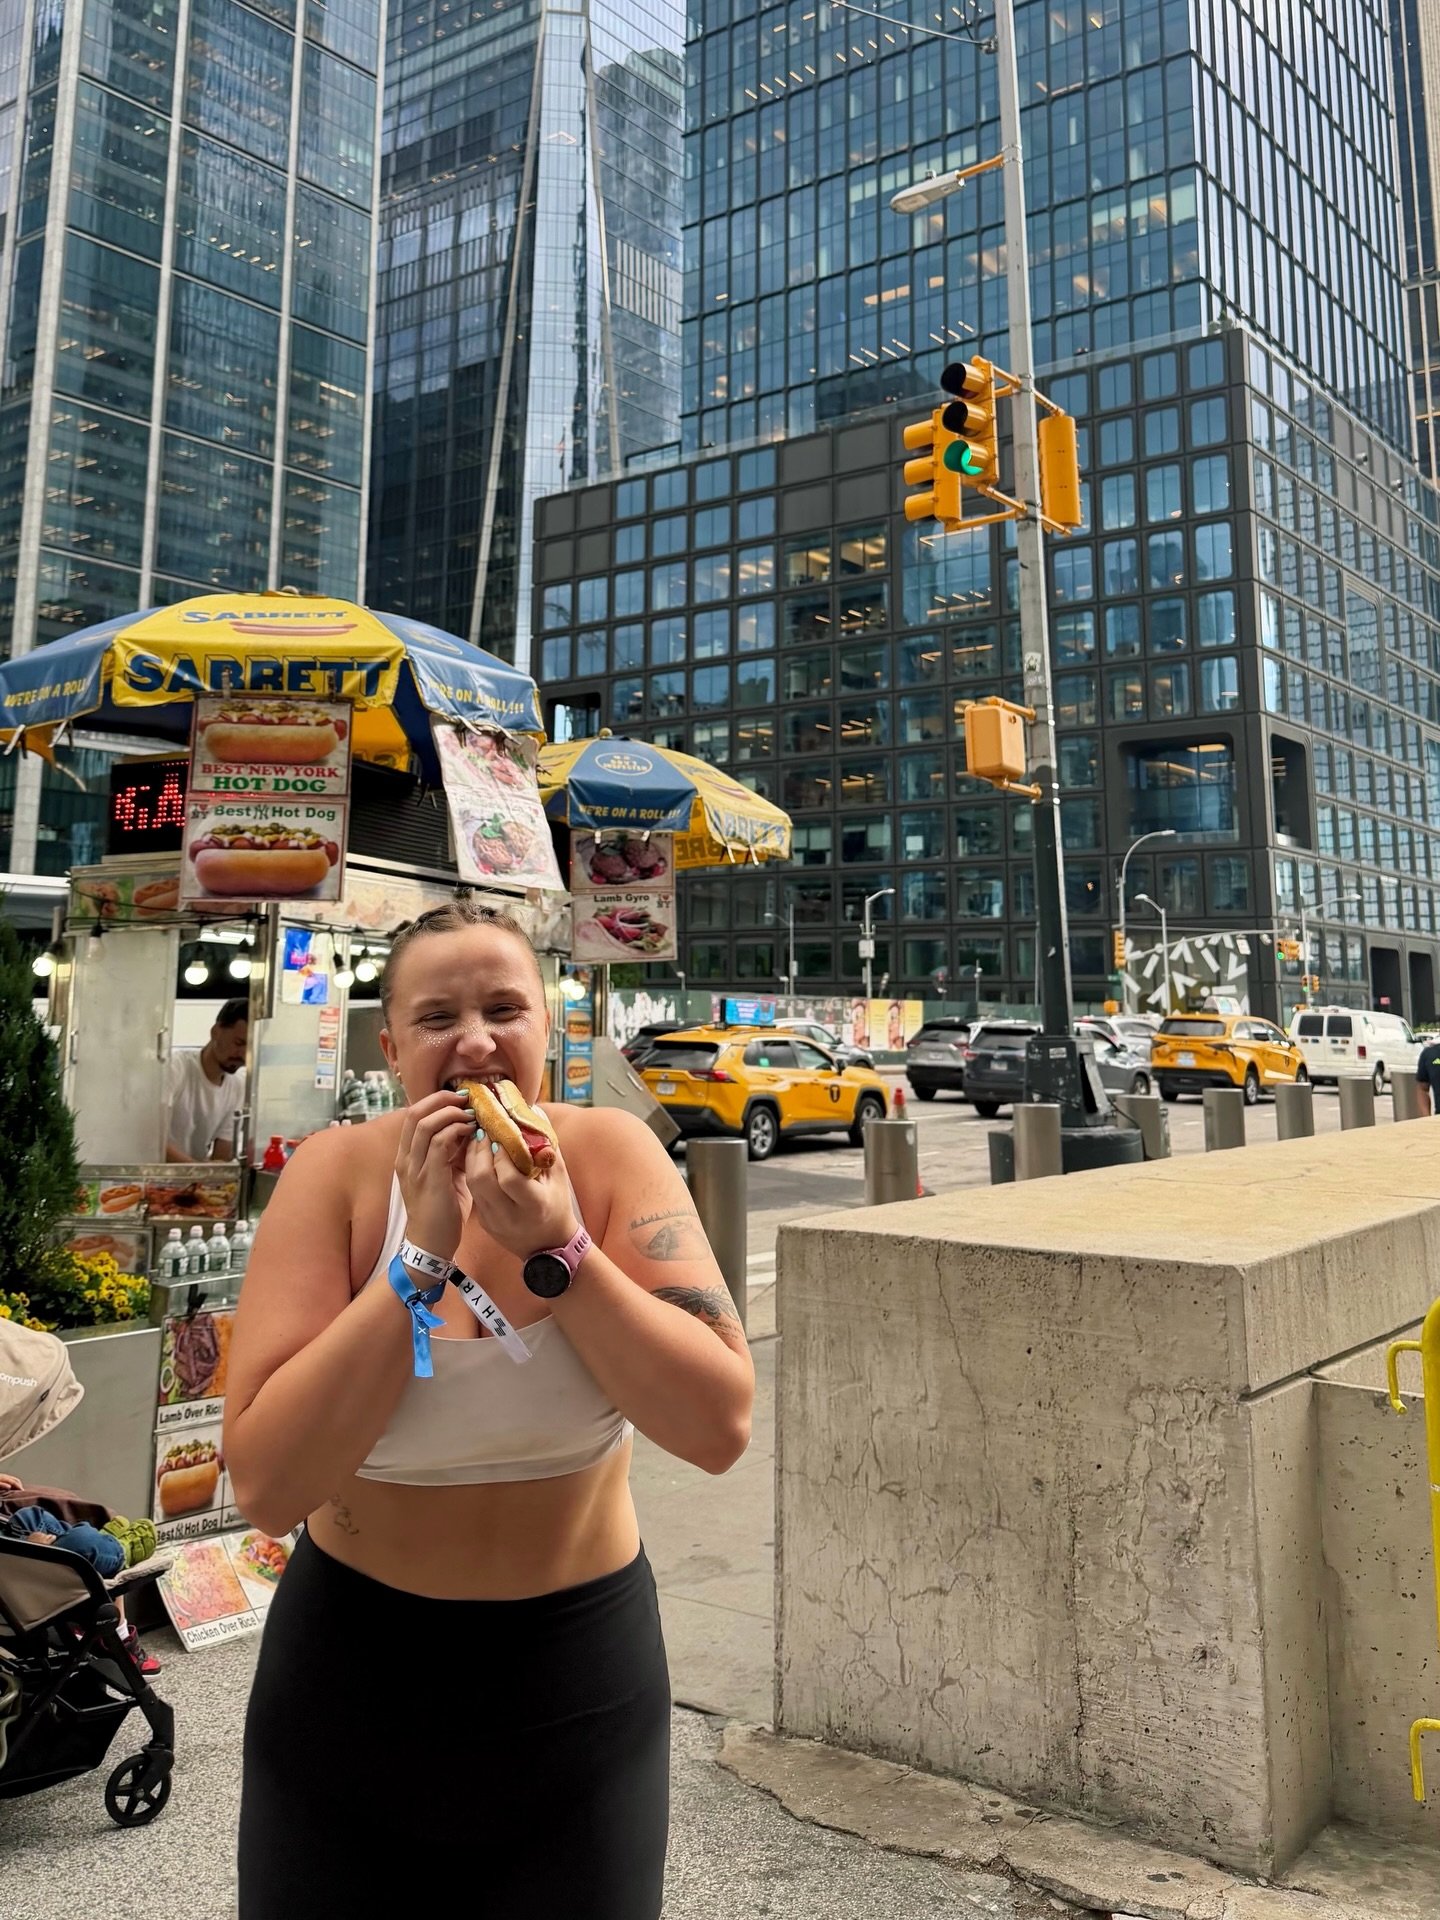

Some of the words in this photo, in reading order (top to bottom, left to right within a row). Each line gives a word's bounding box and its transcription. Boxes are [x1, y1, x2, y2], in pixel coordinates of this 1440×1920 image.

[182, 610, 347, 623] SABRETT
[126, 650, 390, 697] SABRETT
[456, 688, 472, 702] ON
[202, 763, 244, 775] BEST
[248, 765, 289, 777] NEW
[293, 766, 339, 778] YORK
[213, 776, 266, 791] HOT
[272, 778, 327, 793] DOG
[214, 805, 251, 817] Best
[271, 806, 300, 818] Hot
[305, 807, 336, 821] Dog
[611, 807, 628, 818] ON
[630, 808, 638, 819] A
[640, 808, 665, 820] ROLL
[593, 894, 622, 903] Lamb
[625, 893, 650, 904] Gyro
[159, 1410, 183, 1424] Lamb
[184, 1407, 203, 1419] Over
[184, 1521, 200, 1535] Hot
[186, 1627, 220, 1643] Chicken
[219, 1621, 239, 1634] Over
[237, 1616, 257, 1629] Rice
